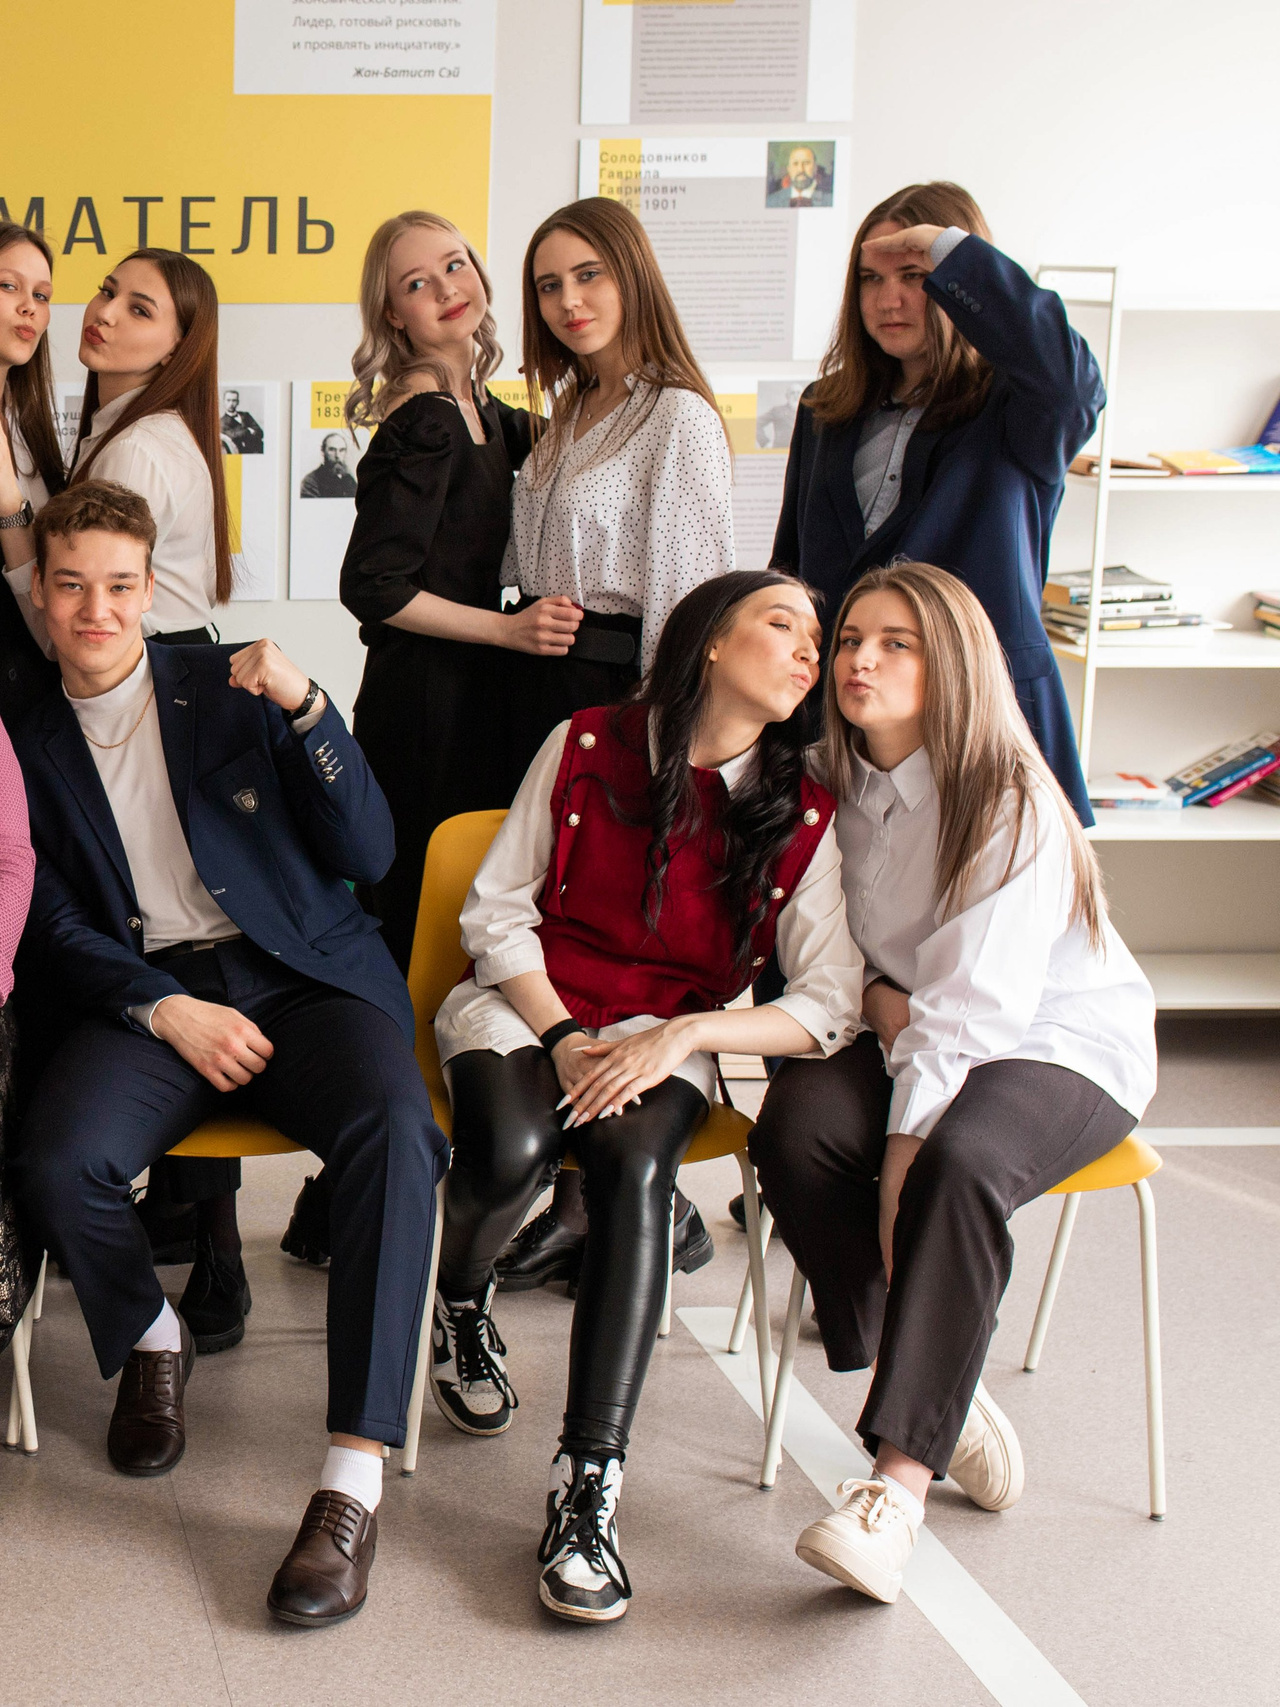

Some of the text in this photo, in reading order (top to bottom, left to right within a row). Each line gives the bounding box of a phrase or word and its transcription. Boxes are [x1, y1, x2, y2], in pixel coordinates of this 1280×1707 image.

[292, 15, 462, 31] Лидер, готовый рисковать
[292, 41, 301, 50] и
[304, 41, 371, 52] проявлять
[353, 66, 460, 79] Жан-Батист Сэй
[599, 151, 708, 164] Солодовников
[599, 167, 661, 181] Гаврила
[599, 183, 687, 197] Гаврилович
